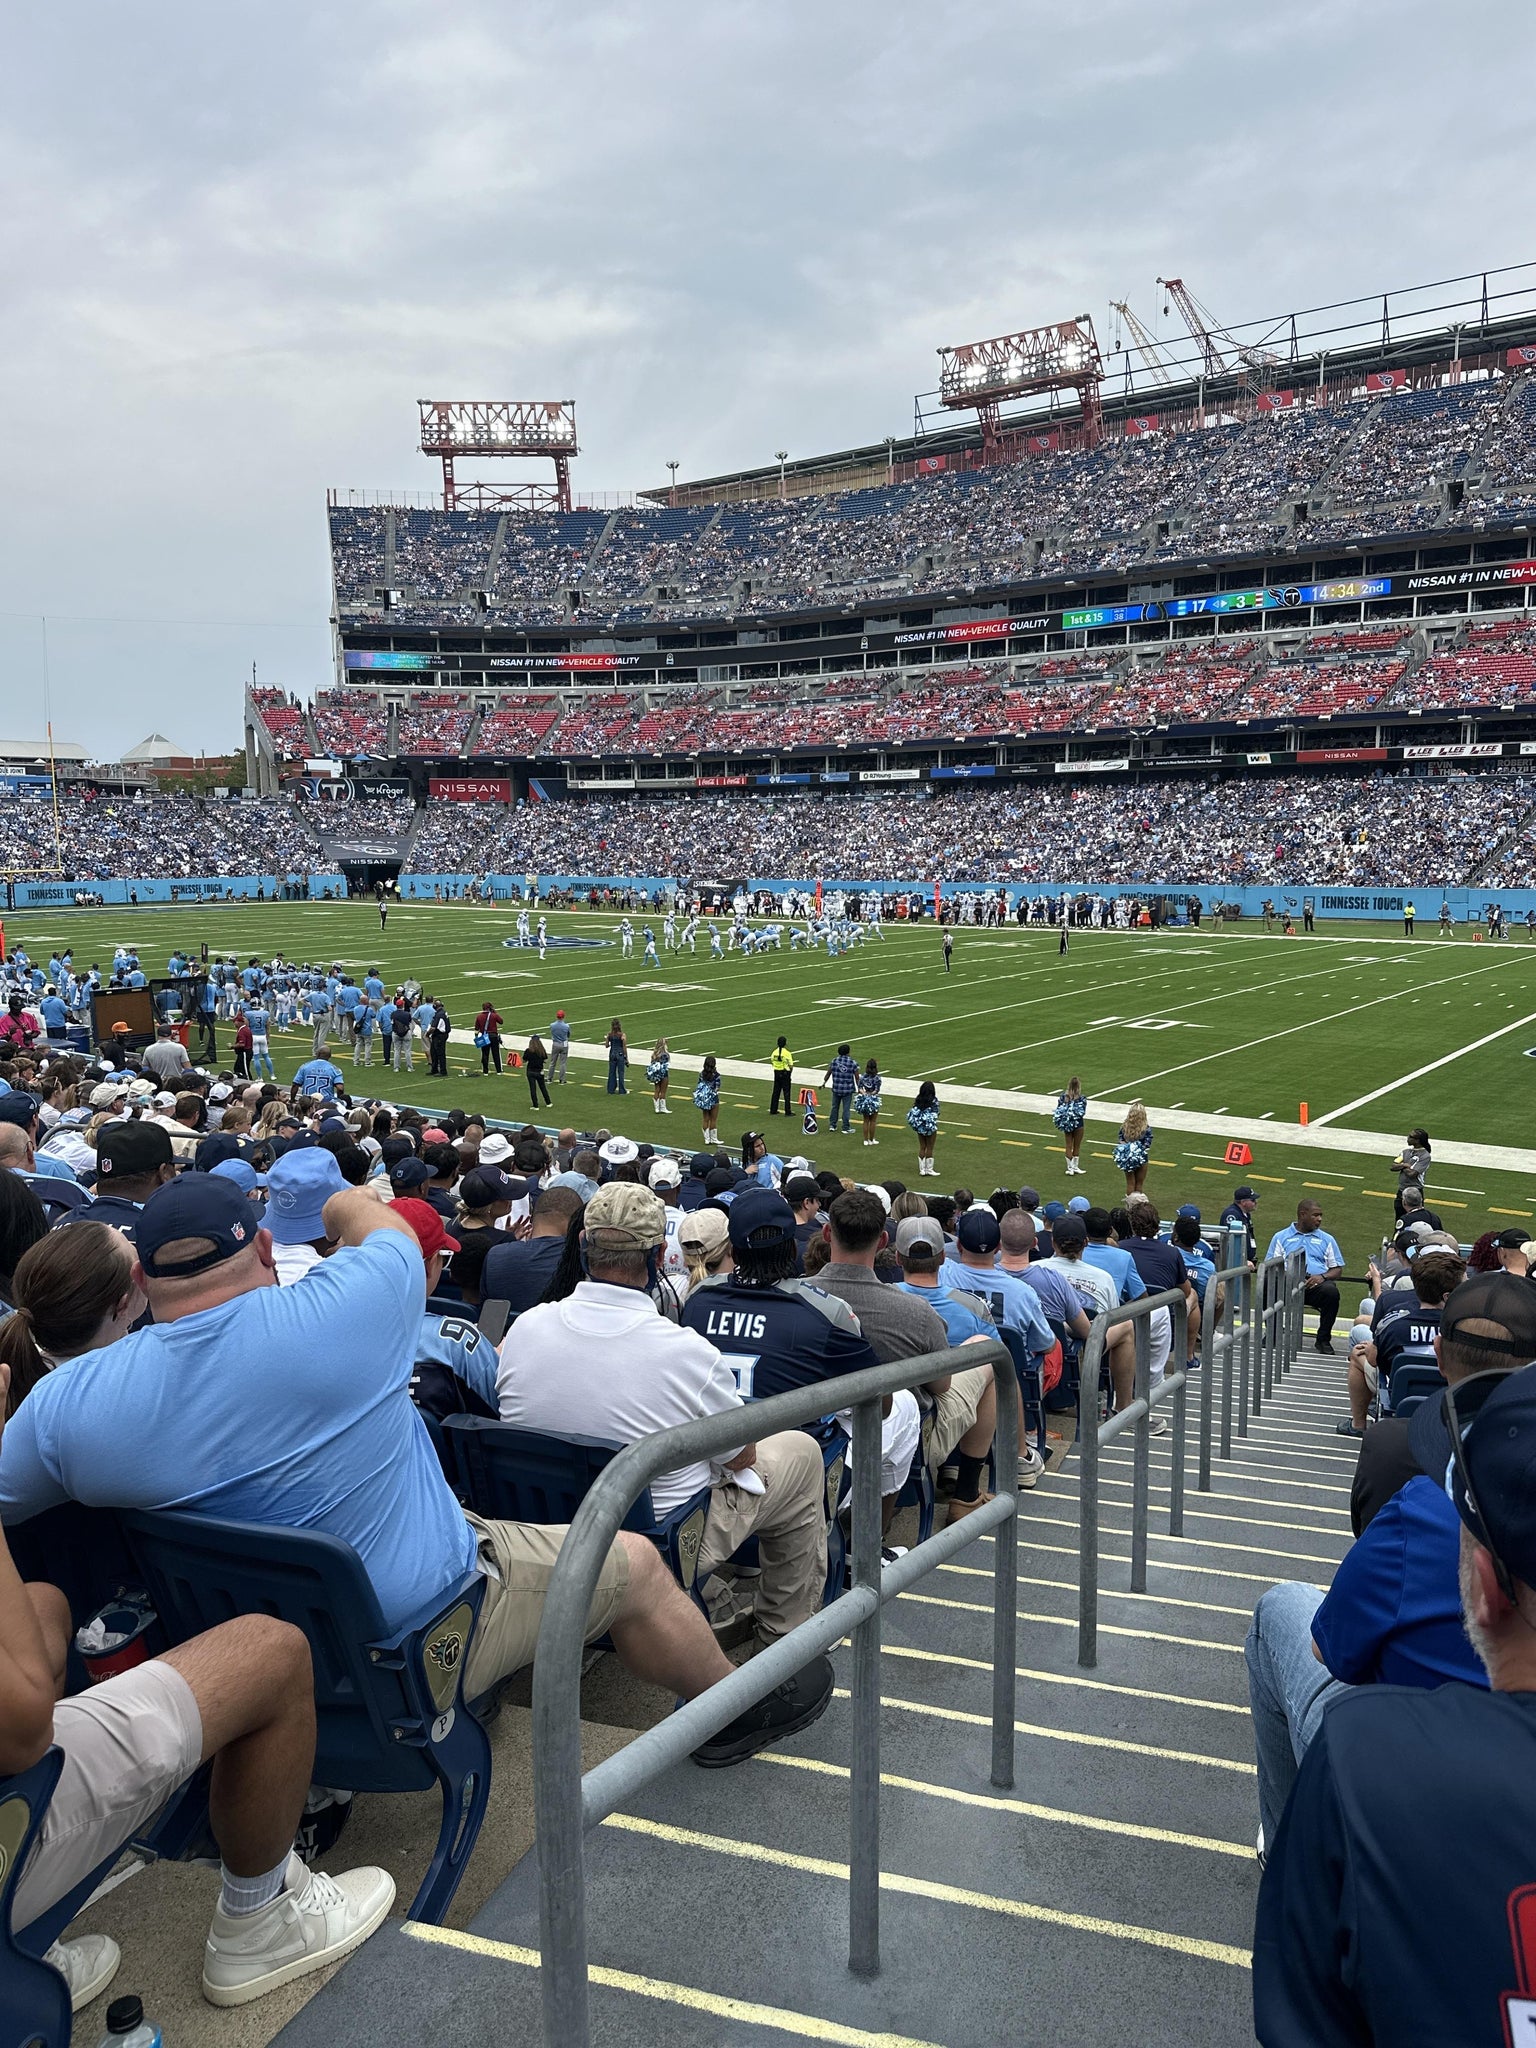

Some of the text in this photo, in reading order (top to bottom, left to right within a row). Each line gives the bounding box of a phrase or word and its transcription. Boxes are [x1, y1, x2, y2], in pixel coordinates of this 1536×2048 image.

[1408, 575, 1457, 588] NISSAN
[1459, 572, 1473, 584] #1
[1475, 570, 1491, 582] IN
[1361, 583, 1384, 595] 2nd
[1192, 600, 1207, 613] 17
[1236, 596, 1246, 609] 3
[1070, 613, 1103, 625] 1st & 15
[1114, 613, 1124, 621] 38
[894, 618, 1050, 644] NISSAN #1 IN NEW-VEHICLE QUALITY
[490, 656, 640, 667] NISSAN #1 IN NEW-VEHICLE QUALITY
[1498, 759, 1534, 767] ROBERT
[376, 783, 404, 799] Kroger
[440, 784, 500, 793] NISSAN
[28, 889, 64, 900] TENNESSEE
[1321, 896, 1404, 911] TENNESSEE TOUGH
[256, 1017, 262, 1029] 3
[508, 1053, 518, 1067] 20
[1229, 1144, 1243, 1162] G
[706, 1310, 767, 1339] LEVIS
[440, 1716, 448, 1735] P
